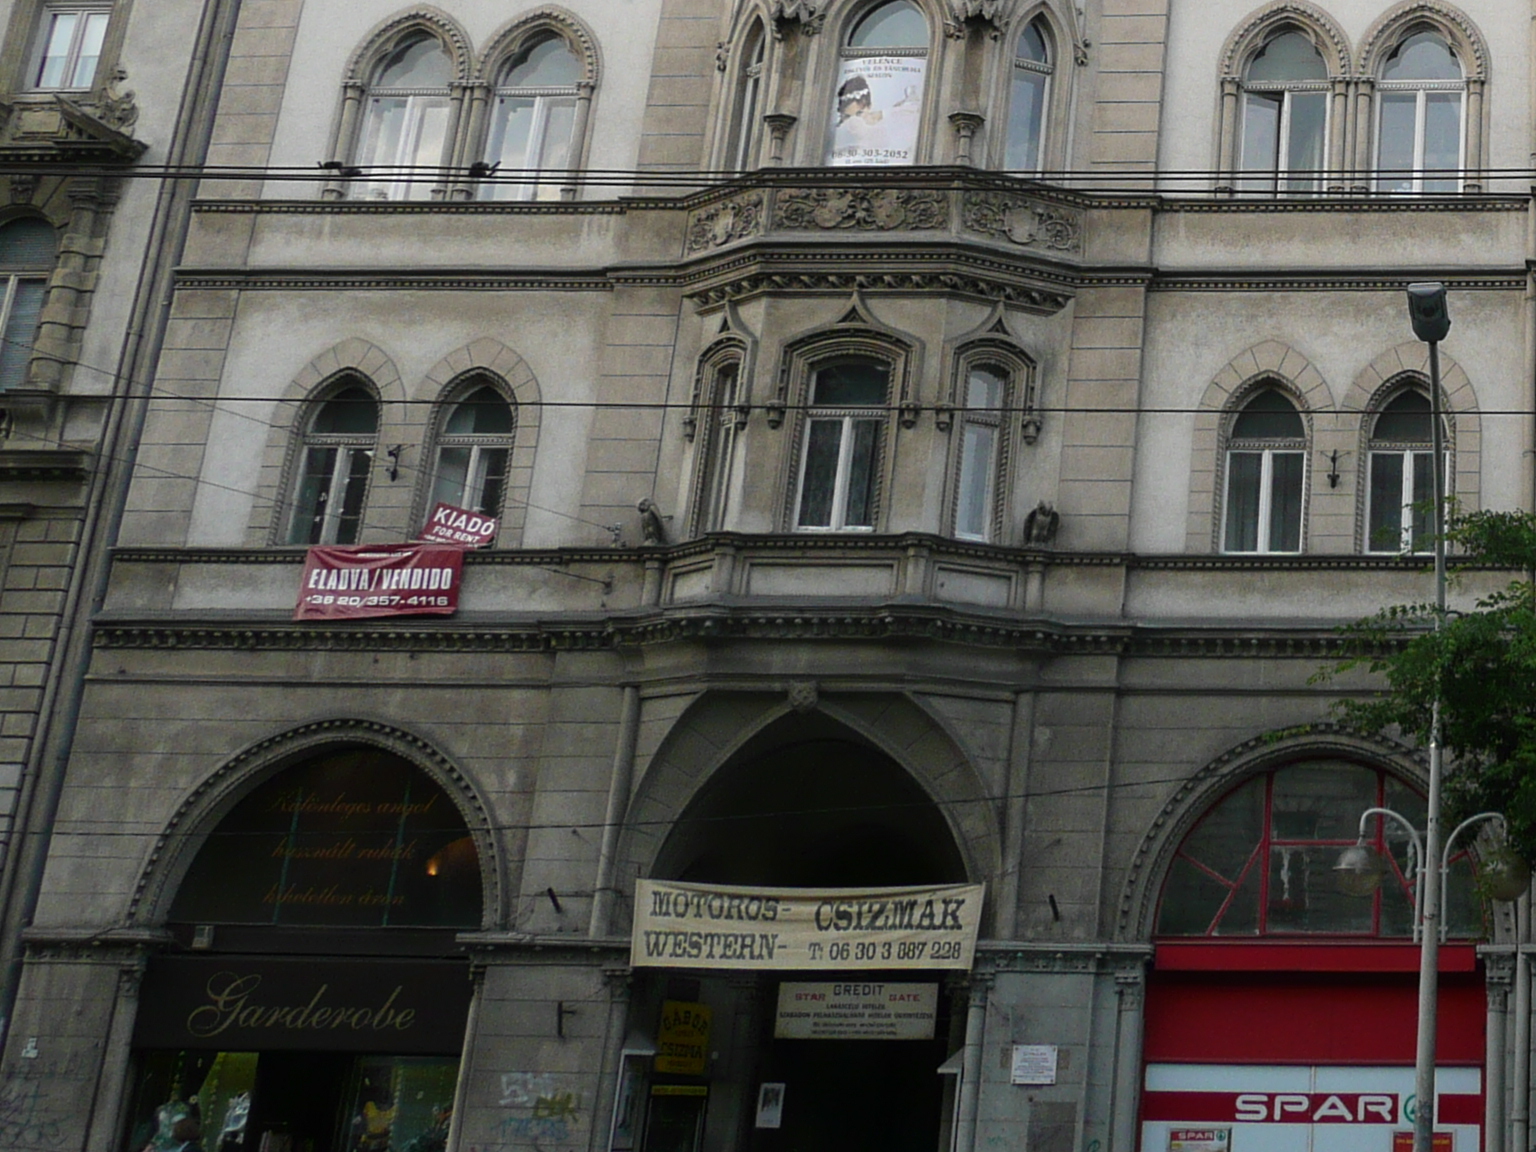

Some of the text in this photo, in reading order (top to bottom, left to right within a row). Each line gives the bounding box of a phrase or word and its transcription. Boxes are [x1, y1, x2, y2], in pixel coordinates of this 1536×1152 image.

[432, 526, 454, 538] FOR
[453, 531, 482, 543] RENT
[433, 507, 496, 535] KIADÓ
[356, 838, 418, 860] ruhák
[650, 891, 967, 931] MOTOROS- CSIZMÁK
[644, 930, 788, 960] WESTERN-
[829, 942, 850, 959] 06
[855, 942, 876, 959] 30
[880, 942, 893, 959] 3
[930, 942, 962, 960] 228
[187, 971, 416, 1037] Garderobe
[795, 993, 826, 1002] STAR
[1235, 1094, 1393, 1122] SPAR
[1178, 1132, 1214, 1141] SPAR
